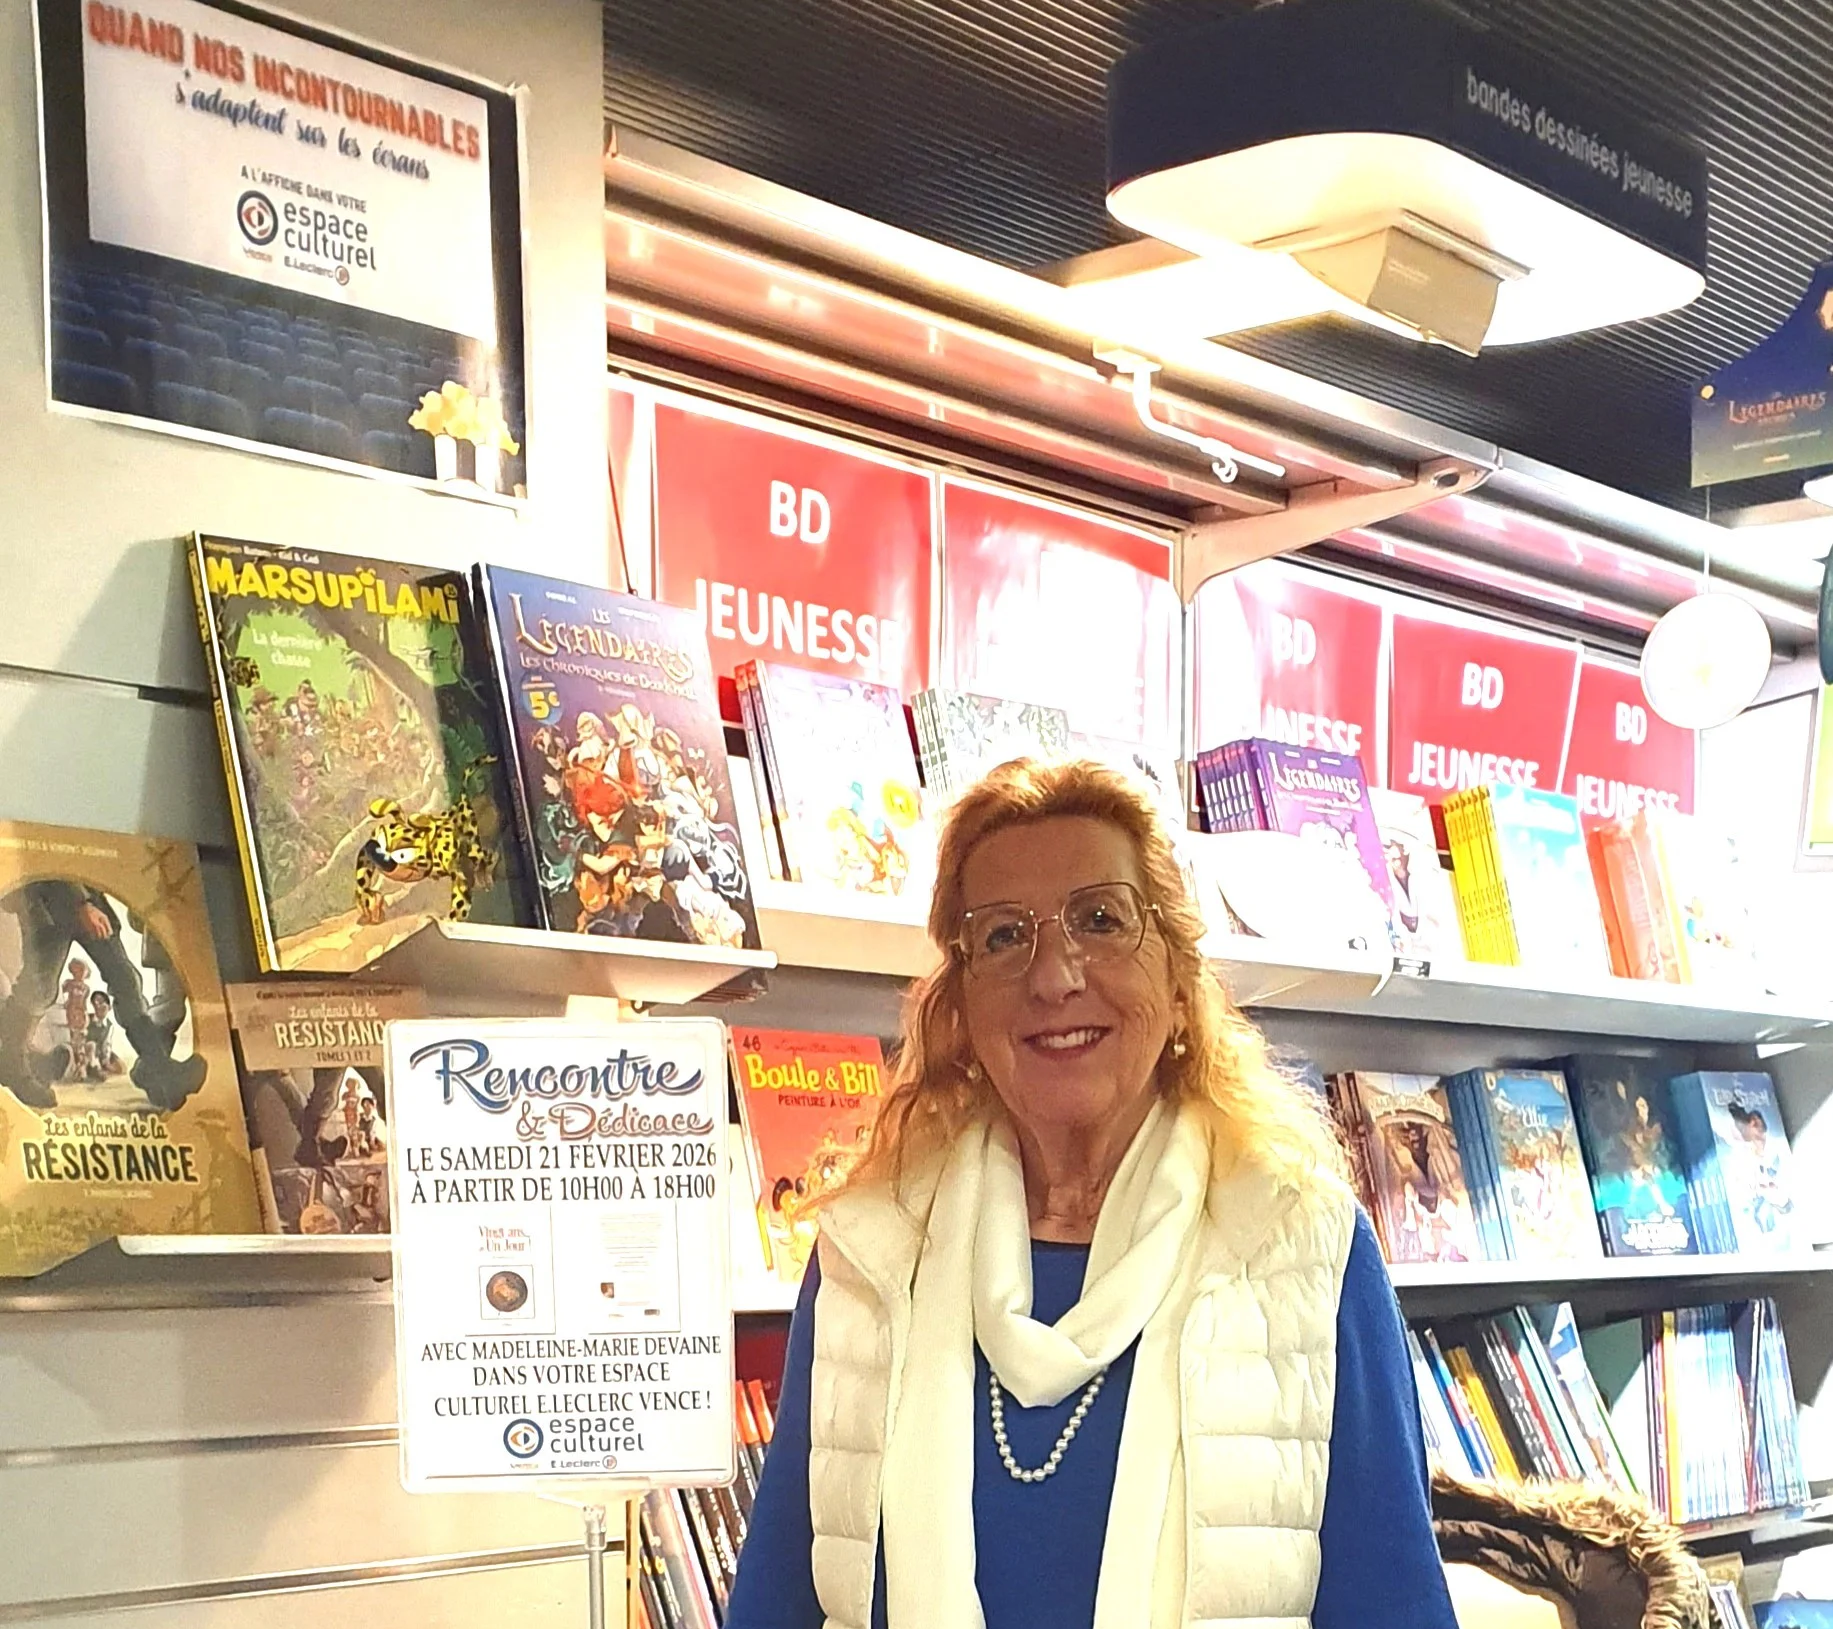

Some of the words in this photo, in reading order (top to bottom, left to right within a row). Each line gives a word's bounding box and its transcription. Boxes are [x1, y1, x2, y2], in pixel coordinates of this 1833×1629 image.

[88, 1, 185, 65] QUAND
[193, 32, 246, 84] NOS
[252, 53, 482, 162] INCONTOURNABLES
[174, 68, 287, 135] s'adaptent
[296, 119, 327, 148] sur
[338, 126, 361, 158] les
[373, 139, 430, 180] écrans
[1466, 66, 1531, 133] bandes
[1535, 106, 1619, 178] dessinées
[1622, 151, 1693, 219] jeunesse
[252, 167, 303, 196] L'AFFICHE
[306, 184, 333, 204] DANS
[336, 193, 367, 213] VOTRE
[283, 201, 368, 243] espace
[284, 227, 376, 270] culturel
[769, 480, 831, 544] BD
[1270, 611, 1317, 665] BD
[1461, 661, 1504, 709] BD
[1262, 704, 1362, 757] NESSE
[1615, 701, 1648, 745] BD
[1408, 741, 1540, 789] JEUNESSE
[274, 1018, 383, 1048] RÉSISTANC
[410, 1038, 705, 1115] Rencontre
[744, 1053, 820, 1092] Boule
[825, 1069, 840, 1092] &
[840, 1060, 883, 1097] Bill
[516, 1100, 547, 1140] &
[549, 1101, 715, 1141] Dédicace
[778, 1094, 826, 1108] PEINTURE
[45, 1116, 69, 1136] Les
[75, 1114, 128, 1143] enfants
[131, 1112, 149, 1139] de
[150, 1116, 168, 1139] la
[23, 1139, 198, 1182] RÉSISTANCE
[407, 1147, 434, 1171] LE
[440, 1145, 532, 1171] SAMEDI
[540, 1145, 561, 1169] 21
[570, 1138, 665, 1169] FÉVRIER
[672, 1143, 717, 1167] 2026
[411, 1171, 427, 1203] À
[435, 1177, 516, 1203] PARTIR
[523, 1176, 552, 1201] DE
[561, 1176, 623, 1200] 10H00
[630, 1167, 646, 1199] À
[654, 1173, 716, 1198] 18H00
[421, 1342, 467, 1362] AVEC
[472, 1338, 640, 1360] MADELEINE-MARIE
[645, 1335, 722, 1355] DEVAINE
[473, 1365, 528, 1386] DANS
[535, 1363, 597, 1385] VOTRE
[602, 1361, 671, 1383] ESPACE
[434, 1395, 532, 1417] CULTUREL
[538, 1393, 634, 1415] E.LECLERC
[639, 1390, 702, 1412] VENCE
[706, 1391, 711, 1410] !
[549, 1416, 636, 1441] espace
[550, 1432, 645, 1453] culturel
